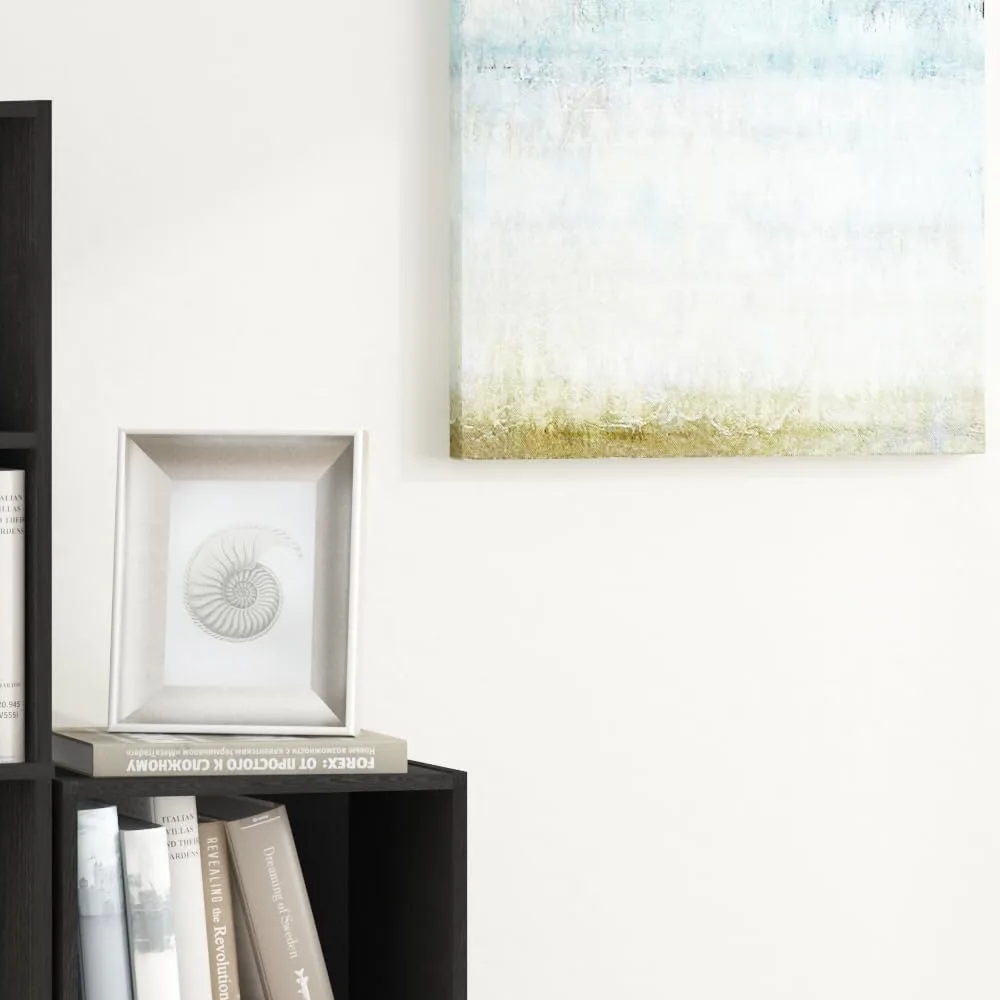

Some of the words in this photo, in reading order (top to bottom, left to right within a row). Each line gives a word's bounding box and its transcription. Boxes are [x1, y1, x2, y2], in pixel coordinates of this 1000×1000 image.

[126, 758, 210, 772] СЛОЖНОМУ
[213, 758, 223, 771] К
[226, 757, 296, 771] ПРОСТОГО
[298, 757, 317, 770] ОТ
[322, 757, 375, 770] FOREX:
[263, 846, 286, 901] Dreaming
[212, 907, 223, 923] the
[277, 903, 290, 916] of
[280, 915, 300, 959] Sweden
[212, 925, 232, 1000] Revolution
